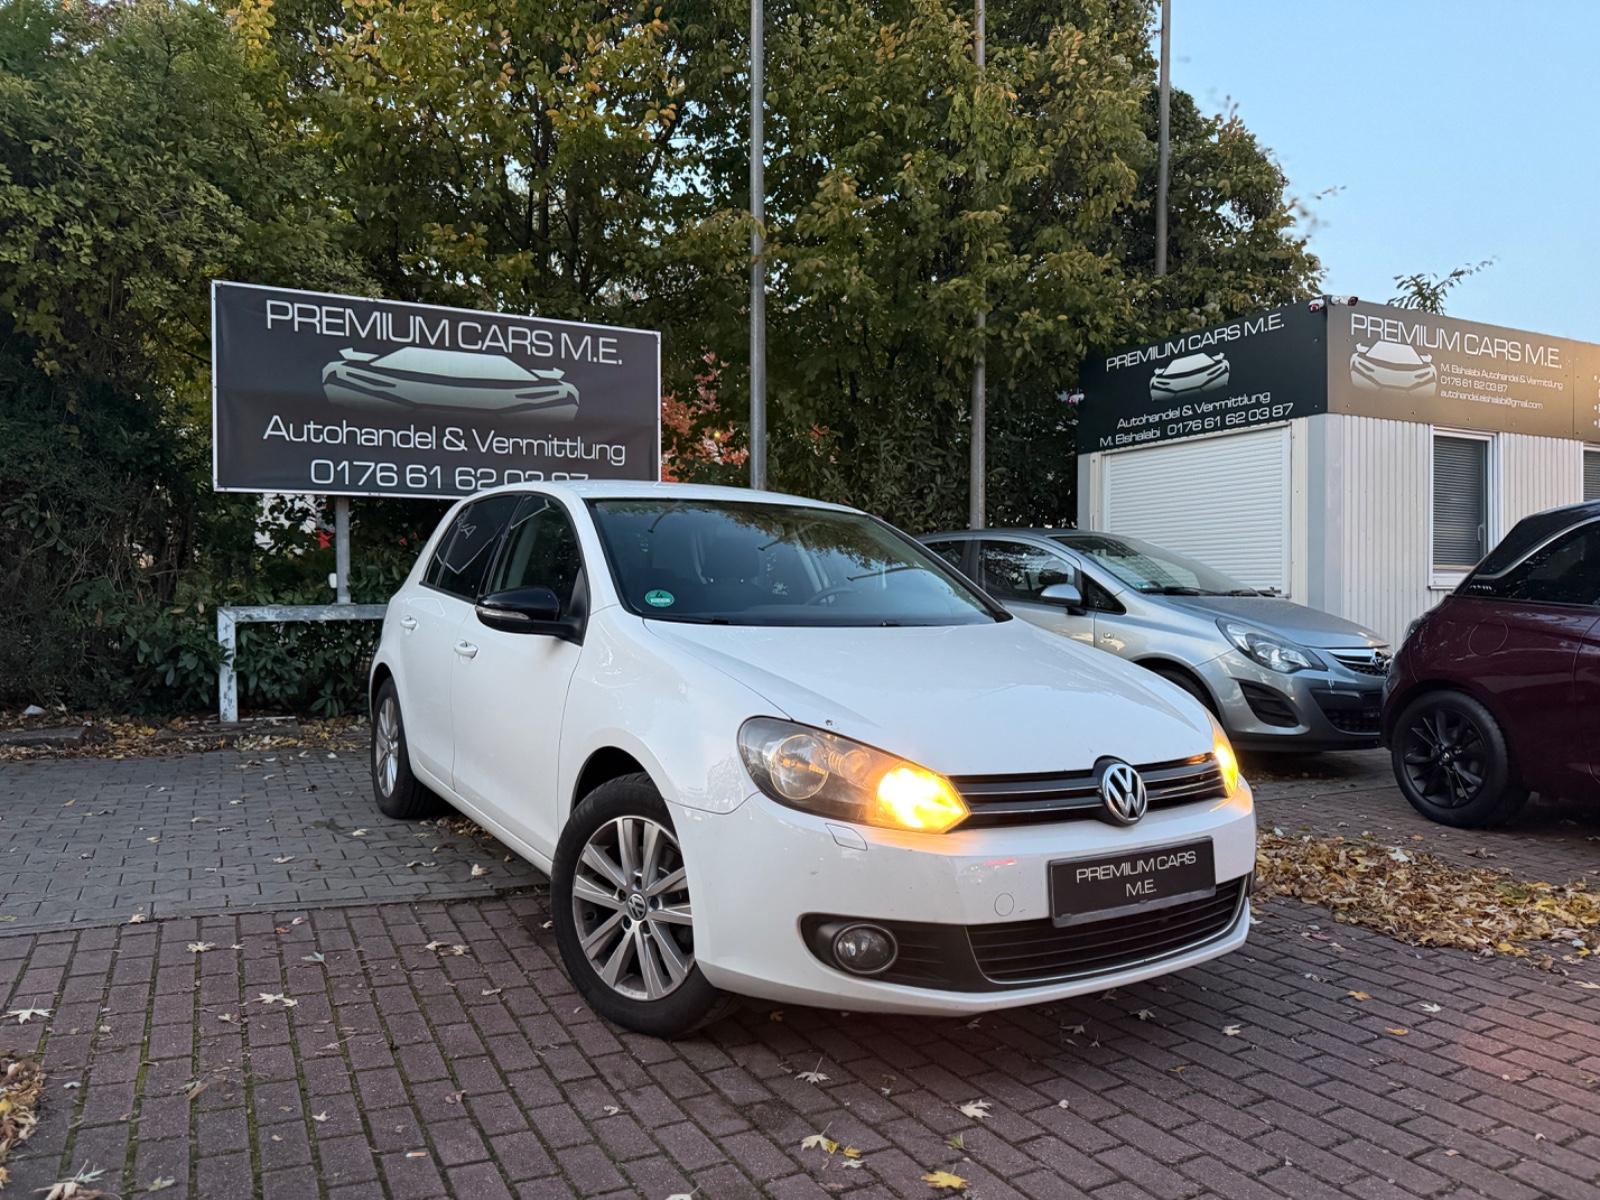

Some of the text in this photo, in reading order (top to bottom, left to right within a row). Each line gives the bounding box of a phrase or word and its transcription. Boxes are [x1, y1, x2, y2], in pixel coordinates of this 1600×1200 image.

[266, 300, 623, 365] PREMIUM CARS M.E.
[1105, 313, 1285, 372] PREMIUM CARS M.E.
[1350, 313, 1563, 369] PREMIUM CARS M.E.
[1099, 435, 1113, 448] M.
[1167, 419, 1202, 436] 0176
[1204, 416, 1221, 429] 61
[1225, 412, 1246, 426] 62
[1248, 407, 1270, 421] 03
[1272, 402, 1294, 417] 87
[1116, 391, 1271, 430] Autohandel & Vermittlung
[262, 415, 626, 466] Autohandel & Vermittlung
[310, 459, 399, 487] 0176
[406, 464, 442, 489] 61
[455, 467, 497, 490] 62
[1076, 850, 1197, 884] PREMIUM CARS
[1125, 879, 1157, 897] M.E.
